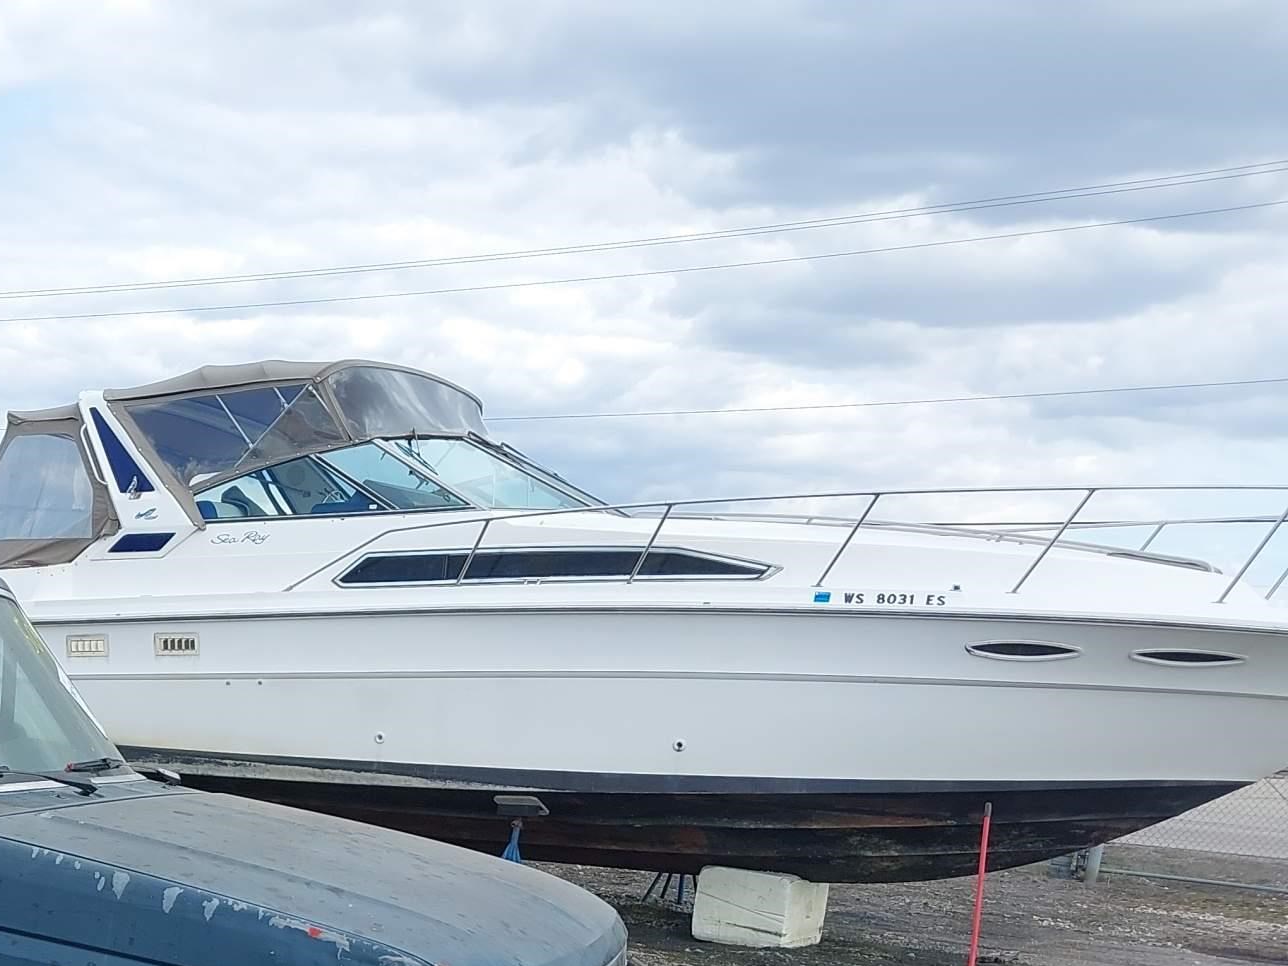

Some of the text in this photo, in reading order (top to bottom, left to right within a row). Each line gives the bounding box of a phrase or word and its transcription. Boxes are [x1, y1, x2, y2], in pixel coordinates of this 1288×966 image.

[210, 530, 272, 545] Sea Ray
[843, 592, 947, 607] WS 8031 ES
